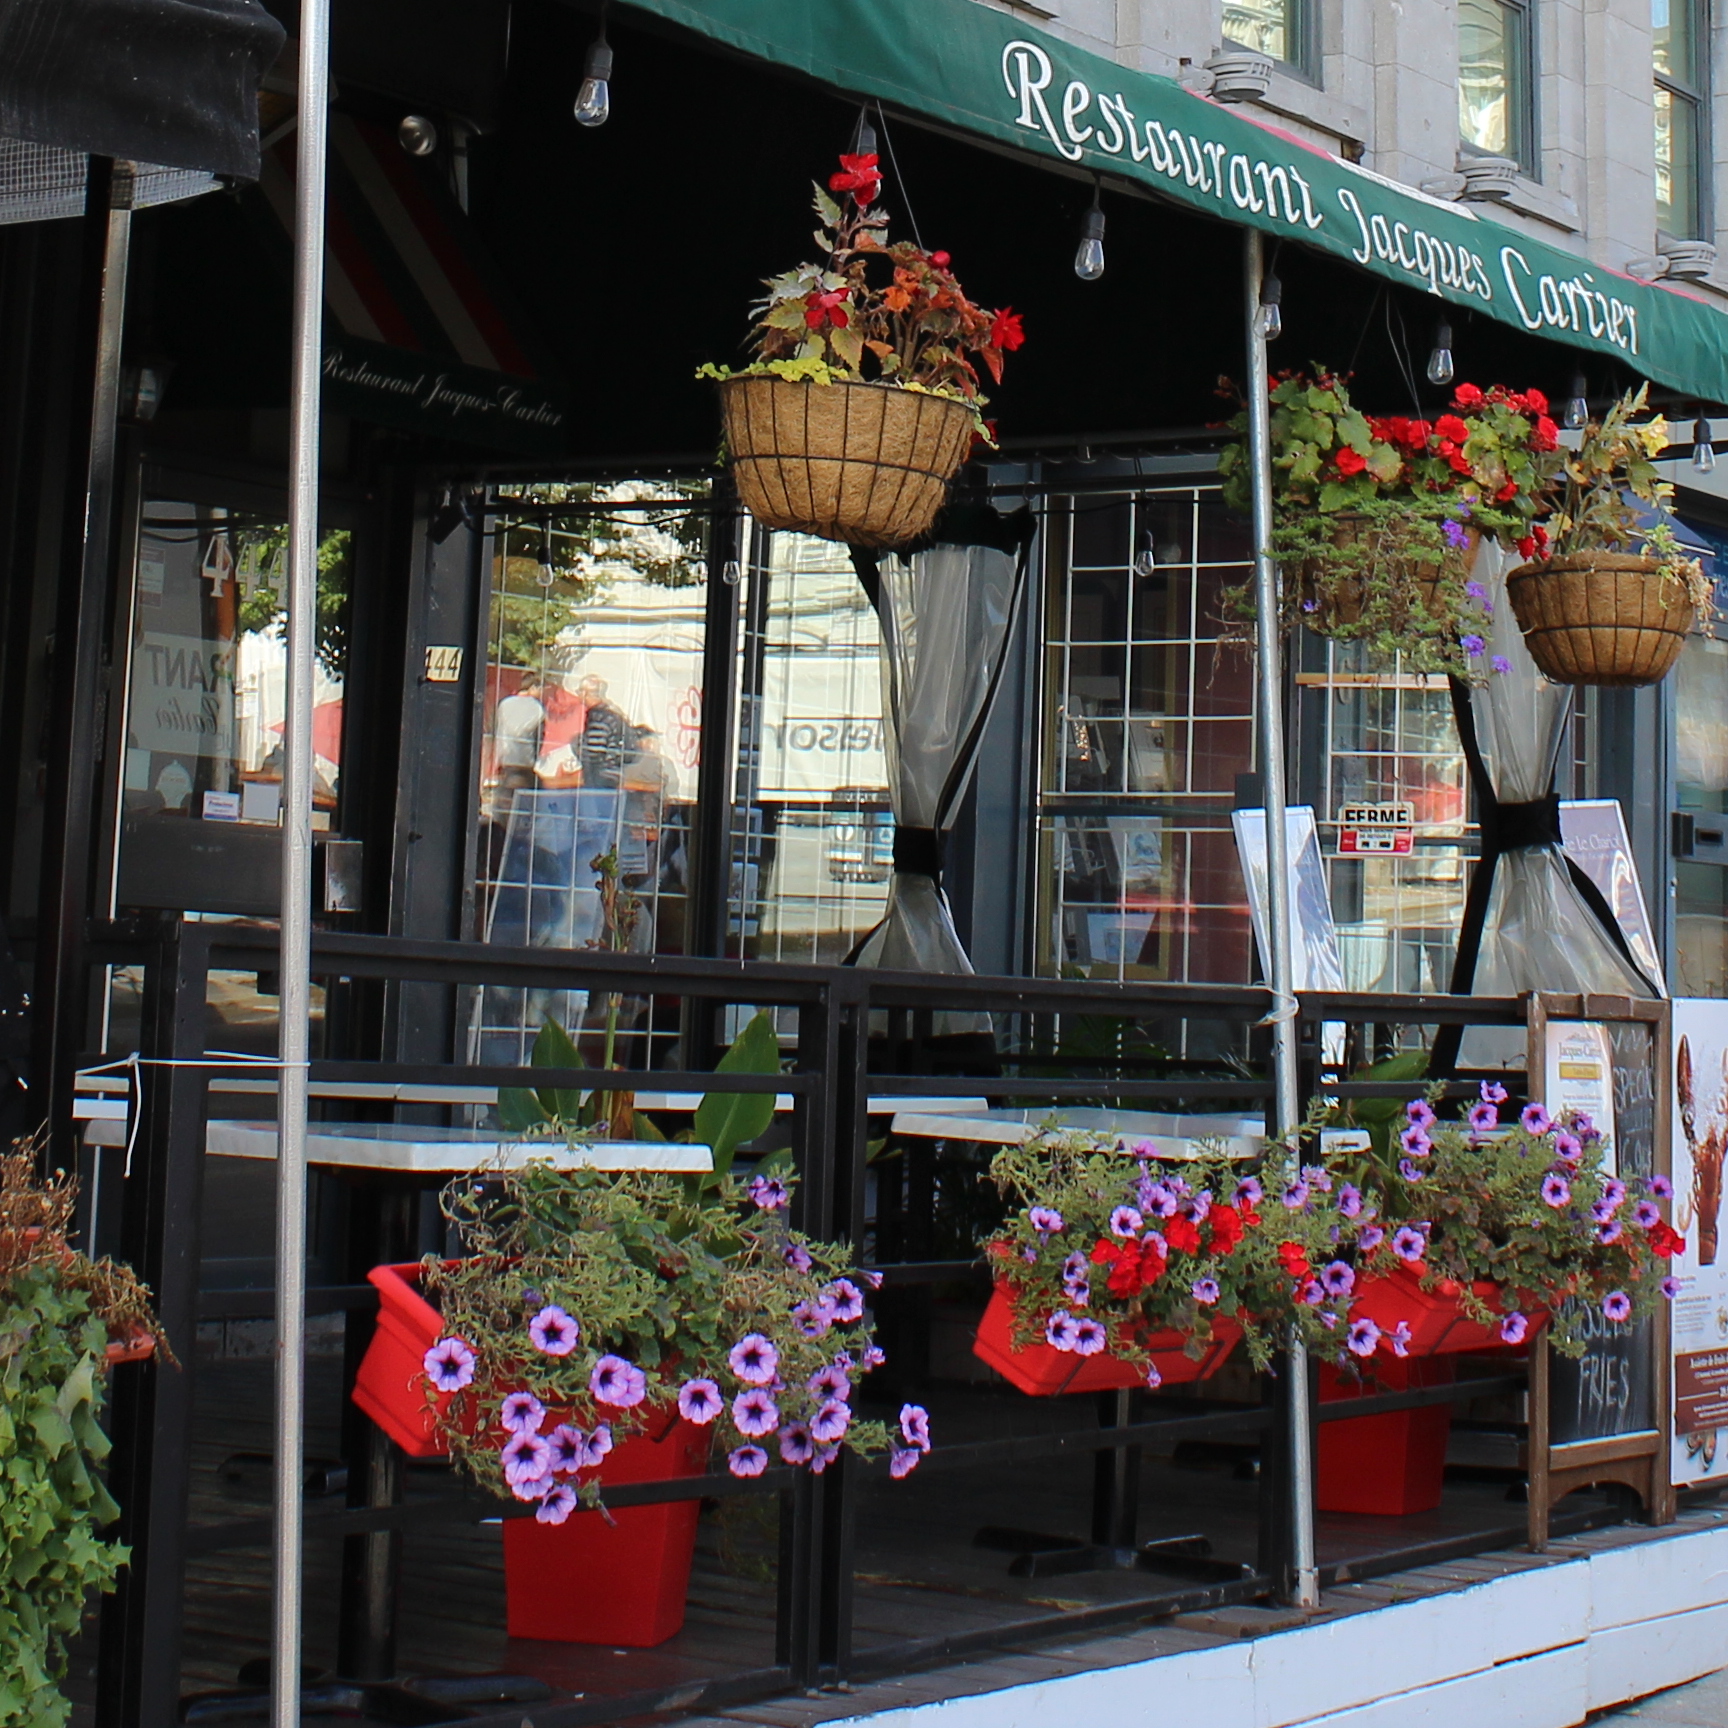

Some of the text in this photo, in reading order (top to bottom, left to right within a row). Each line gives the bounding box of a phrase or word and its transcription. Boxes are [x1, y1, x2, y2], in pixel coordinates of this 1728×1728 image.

[1001, 39, 1640, 356] Restaurant Jacques Cartier
[322, 346, 425, 396] Restaurant
